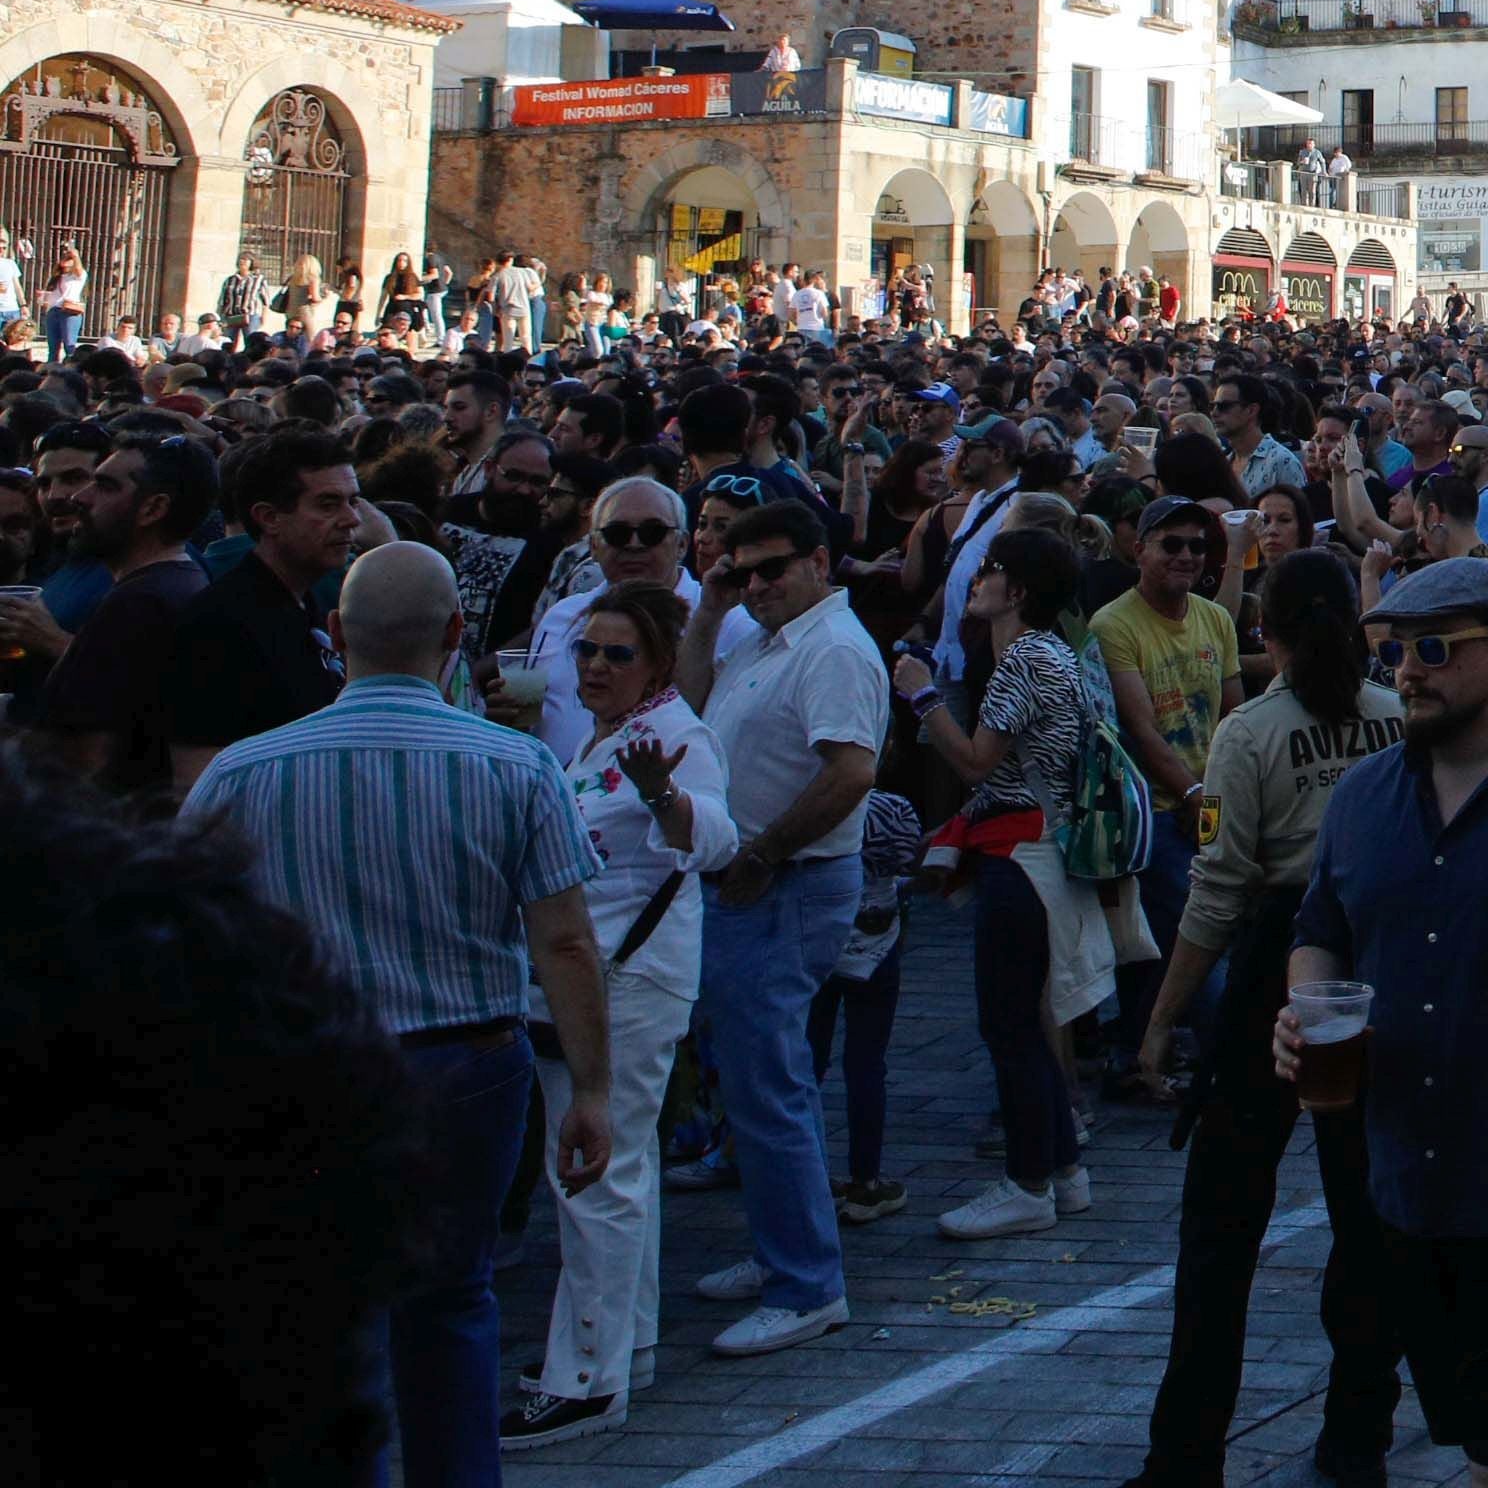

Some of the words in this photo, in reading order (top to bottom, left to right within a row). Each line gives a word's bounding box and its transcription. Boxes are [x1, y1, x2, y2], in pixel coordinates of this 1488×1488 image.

[532, 86, 582, 103] Festival
[587, 83, 632, 100] Womad
[1344, 220, 1407, 238] TURISMO
[1295, 775, 1314, 793] P.
